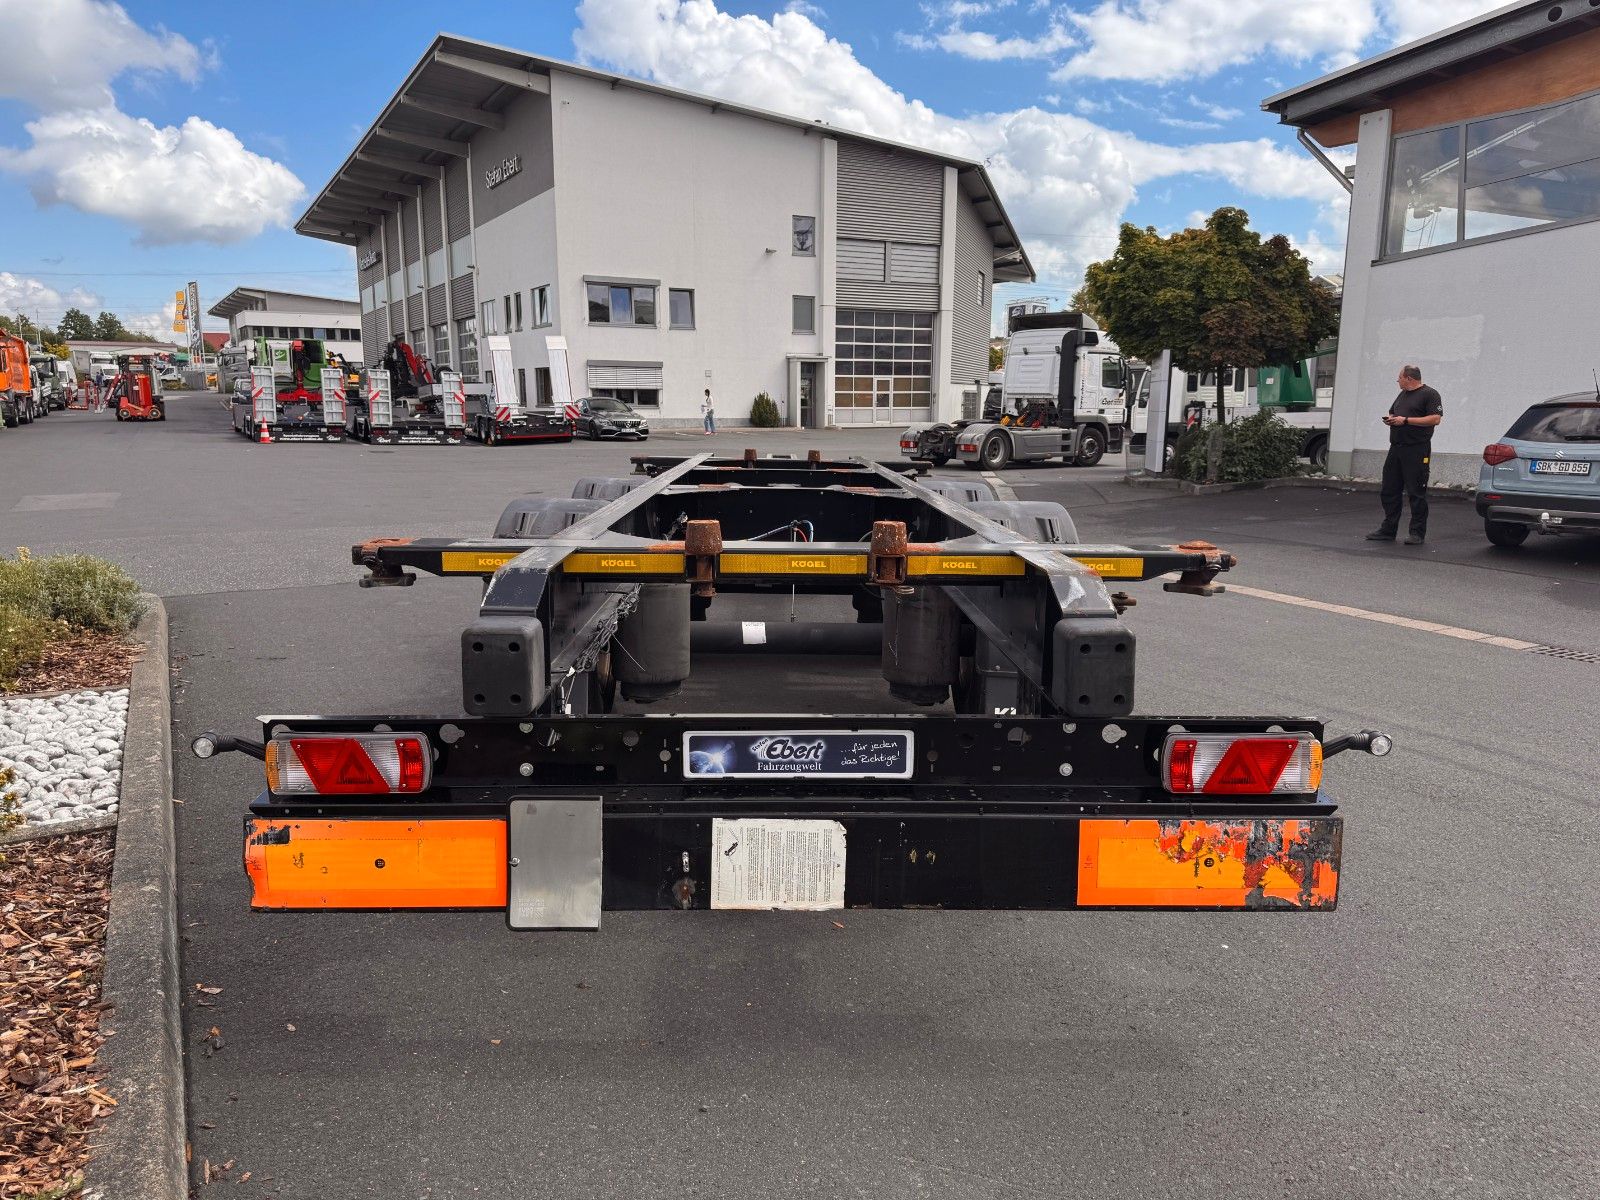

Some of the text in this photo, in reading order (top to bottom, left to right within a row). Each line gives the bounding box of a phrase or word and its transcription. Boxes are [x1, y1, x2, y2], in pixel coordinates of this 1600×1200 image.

[1536, 461, 1589, 473] SBK GD 855
[478, 558, 506, 566] KÖG
[601, 559, 637, 567] KÖGEL
[791, 560, 827, 568] KÖGEL
[942, 561, 978, 569] KÖGEL
[1087, 563, 1117, 571] ÖGEL
[751, 738, 769, 752] Stefan
[766, 739, 824, 760] Ebert
[870, 740, 898, 752] jeden
[841, 750, 900, 767] das Richtige!
[757, 762, 822, 773] Fahrzeugwelt
